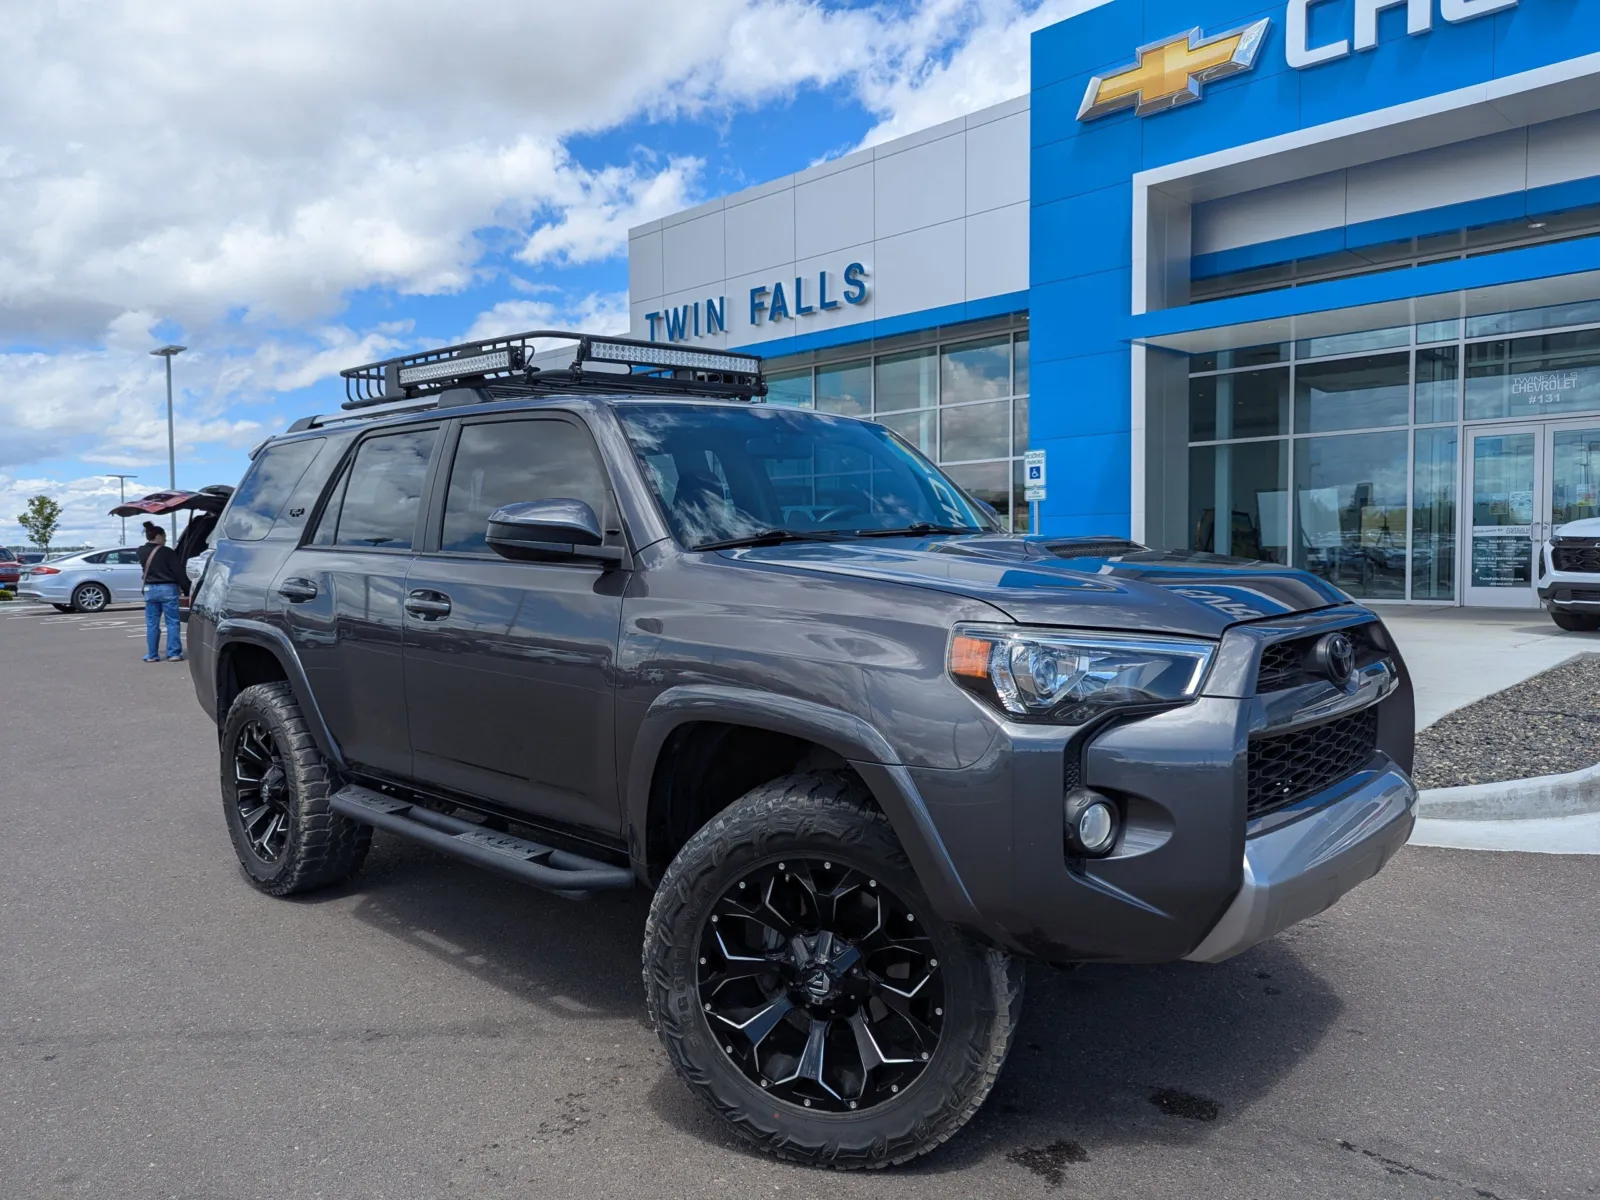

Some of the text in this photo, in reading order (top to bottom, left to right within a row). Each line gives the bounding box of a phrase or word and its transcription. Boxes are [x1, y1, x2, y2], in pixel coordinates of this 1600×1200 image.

[1286, 0, 1518, 68] CH
[645, 262, 868, 342] TWIN FALLS
[1512, 379, 1577, 394] CHEVROLET
[1528, 393, 1561, 404] #131
